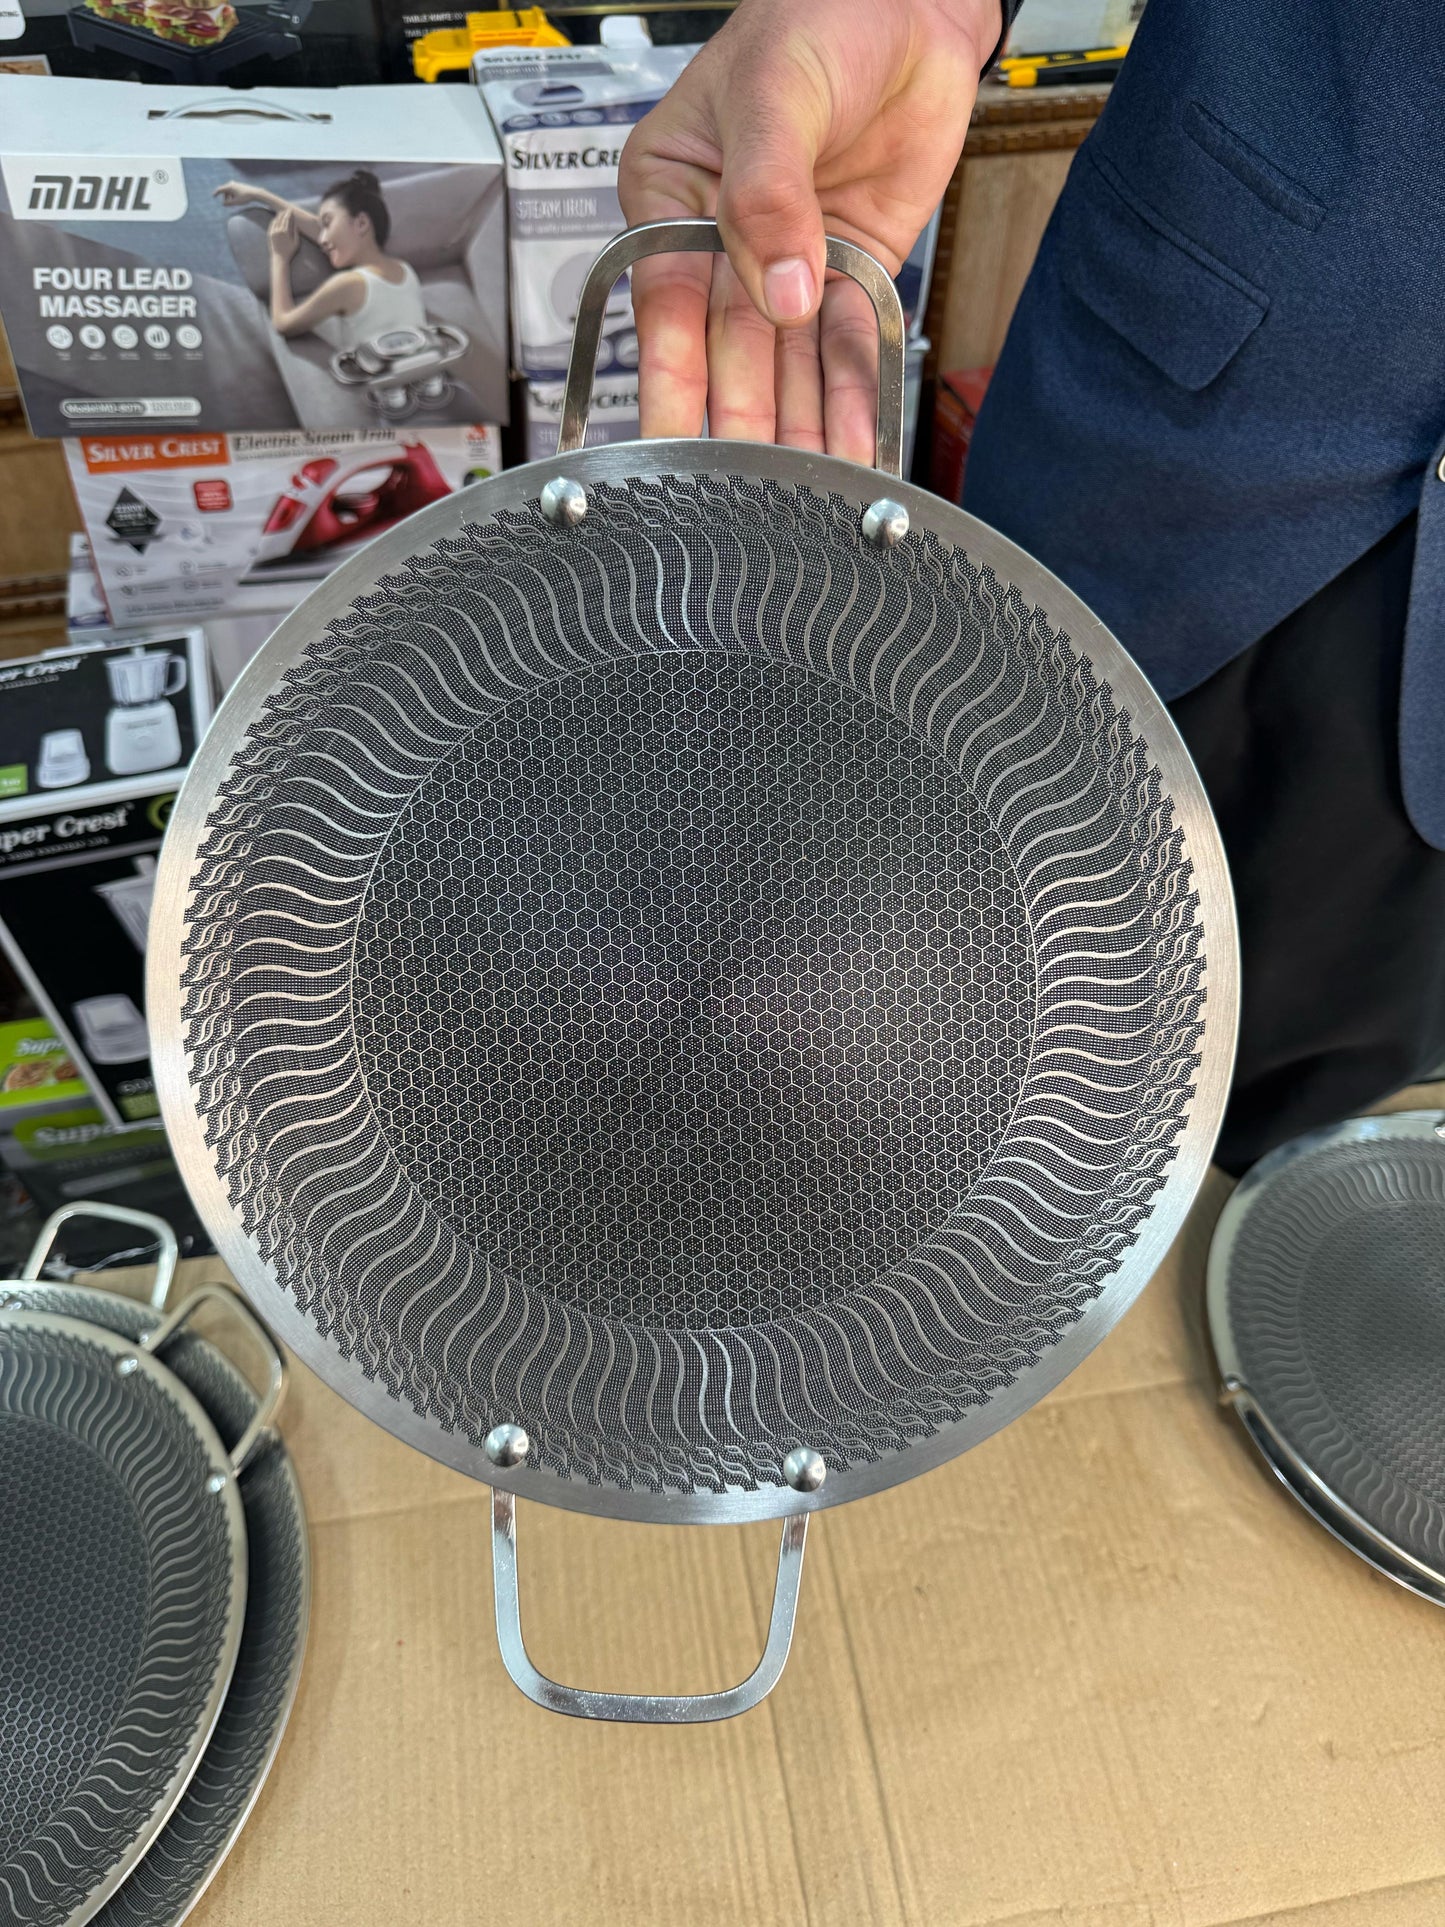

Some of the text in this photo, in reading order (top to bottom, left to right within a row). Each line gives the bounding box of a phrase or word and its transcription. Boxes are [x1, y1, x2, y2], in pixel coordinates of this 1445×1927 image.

[512, 147, 620, 171] SILVERCRE
[28, 175, 152, 211] MDHL
[32, 266, 193, 291] FOUR LEAD
[39, 295, 198, 318] MASSAGER
[88, 442, 155, 463] SILVER
[160, 437, 221, 458] CREST
[233, 427, 396, 449] Electric Steam Iron
[24, 655, 83, 677] Crest
[0, 807, 128, 853] per Crest
